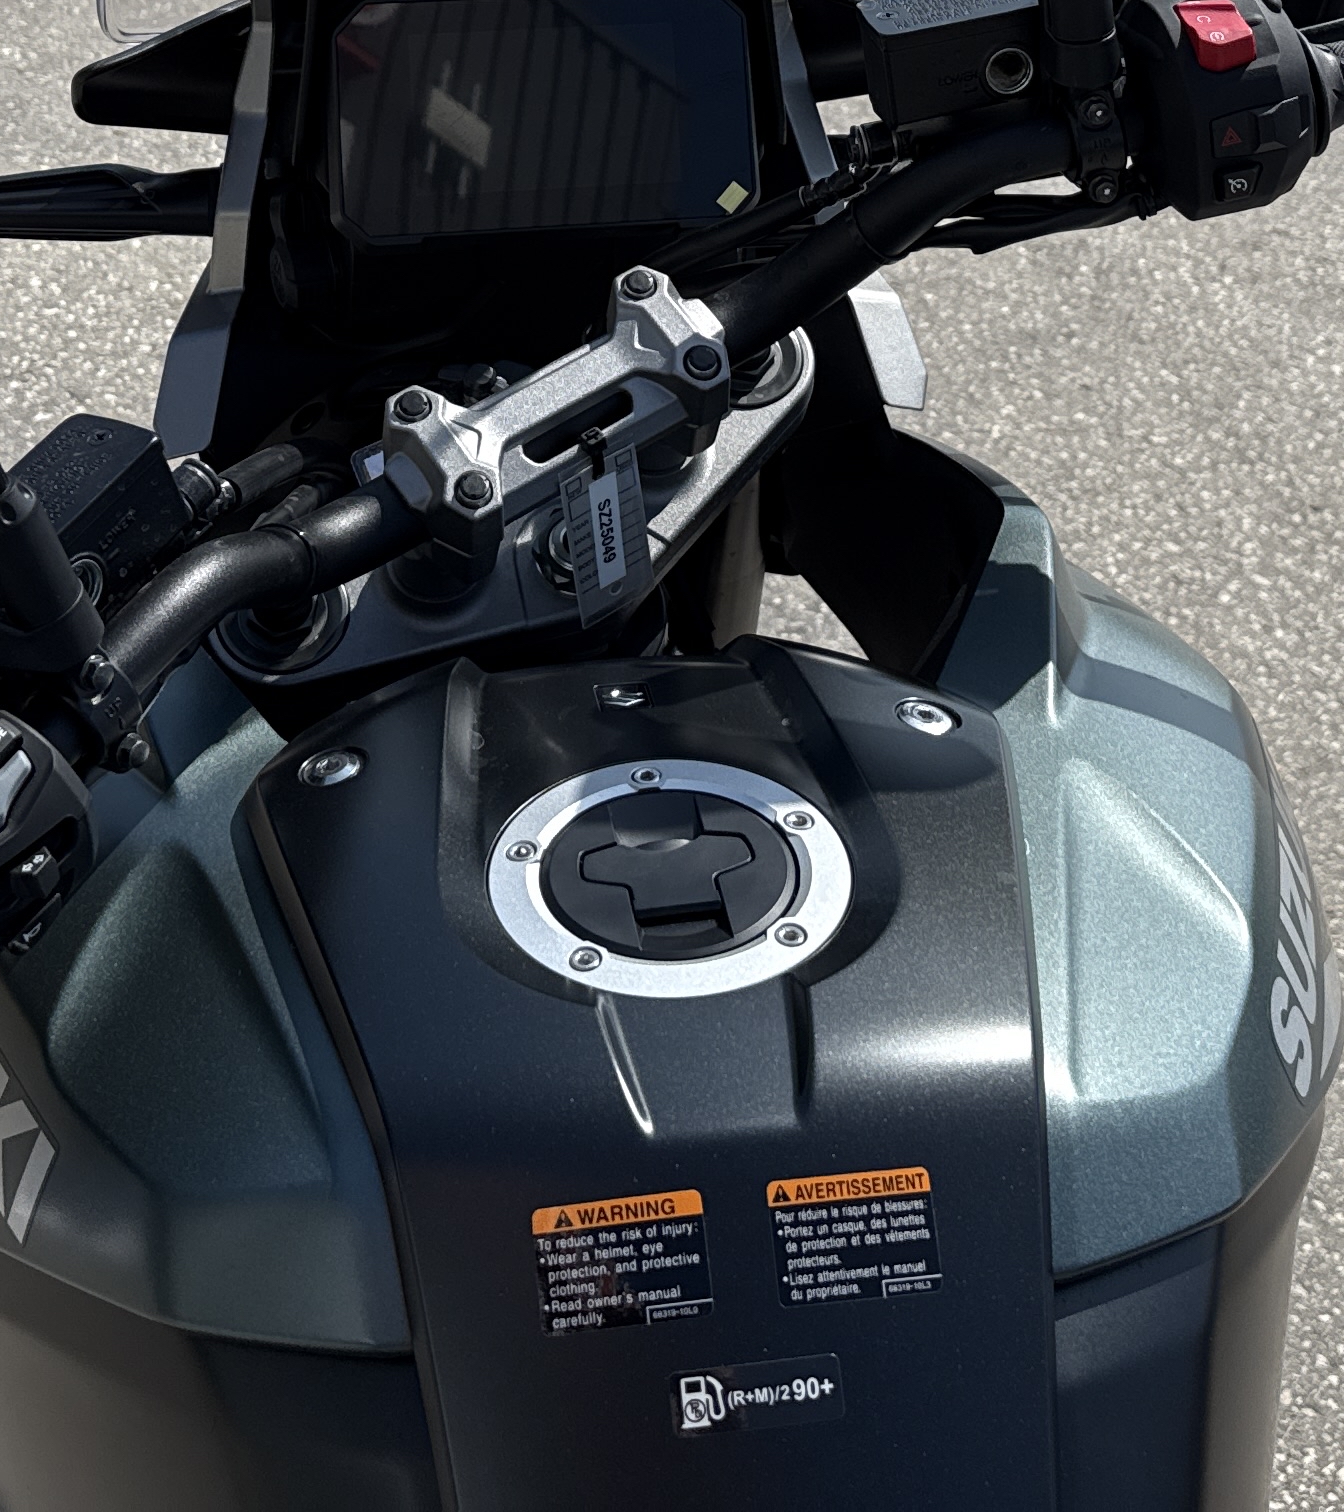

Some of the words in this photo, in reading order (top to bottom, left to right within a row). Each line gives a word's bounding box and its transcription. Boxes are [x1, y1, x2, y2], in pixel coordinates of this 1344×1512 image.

[598, 498, 617, 564] SZ25049
[795, 1173, 924, 1201] AVERTISSEMENT
[577, 1198, 675, 1225] WARNING
[775, 1211, 795, 1224] Pour
[798, 1207, 828, 1222] réduire
[831, 1206, 839, 1218] le
[842, 1204, 868, 1219] risque
[871, 1202, 882, 1214] de
[817, 1223, 829, 1234] un
[870, 1217, 887, 1229] des
[890, 1214, 925, 1227] lunettes
[537, 1239, 551, 1252] To
[556, 1234, 594, 1248] reduce
[599, 1231, 617, 1244] the
[622, 1227, 642, 1240] risk
[646, 1225, 656, 1237] of
[662, 1222, 699, 1237] injury:
[785, 1240, 798, 1253] de
[801, 1236, 847, 1253] protection
[851, 1234, 861, 1246] et
[864, 1232, 881, 1245] des
[582, 1251, 590, 1262] a
[642, 1242, 663, 1255] eye
[615, 1260, 637, 1273] and
[642, 1252, 700, 1273] protective
[817, 1265, 878, 1282] attentivement
[881, 1263, 890, 1276] le
[894, 1260, 926, 1273] manuel
[638, 1285, 681, 1302] manual
[790, 1289, 803, 1301] du
[792, 1376, 834, 1401] 90+
